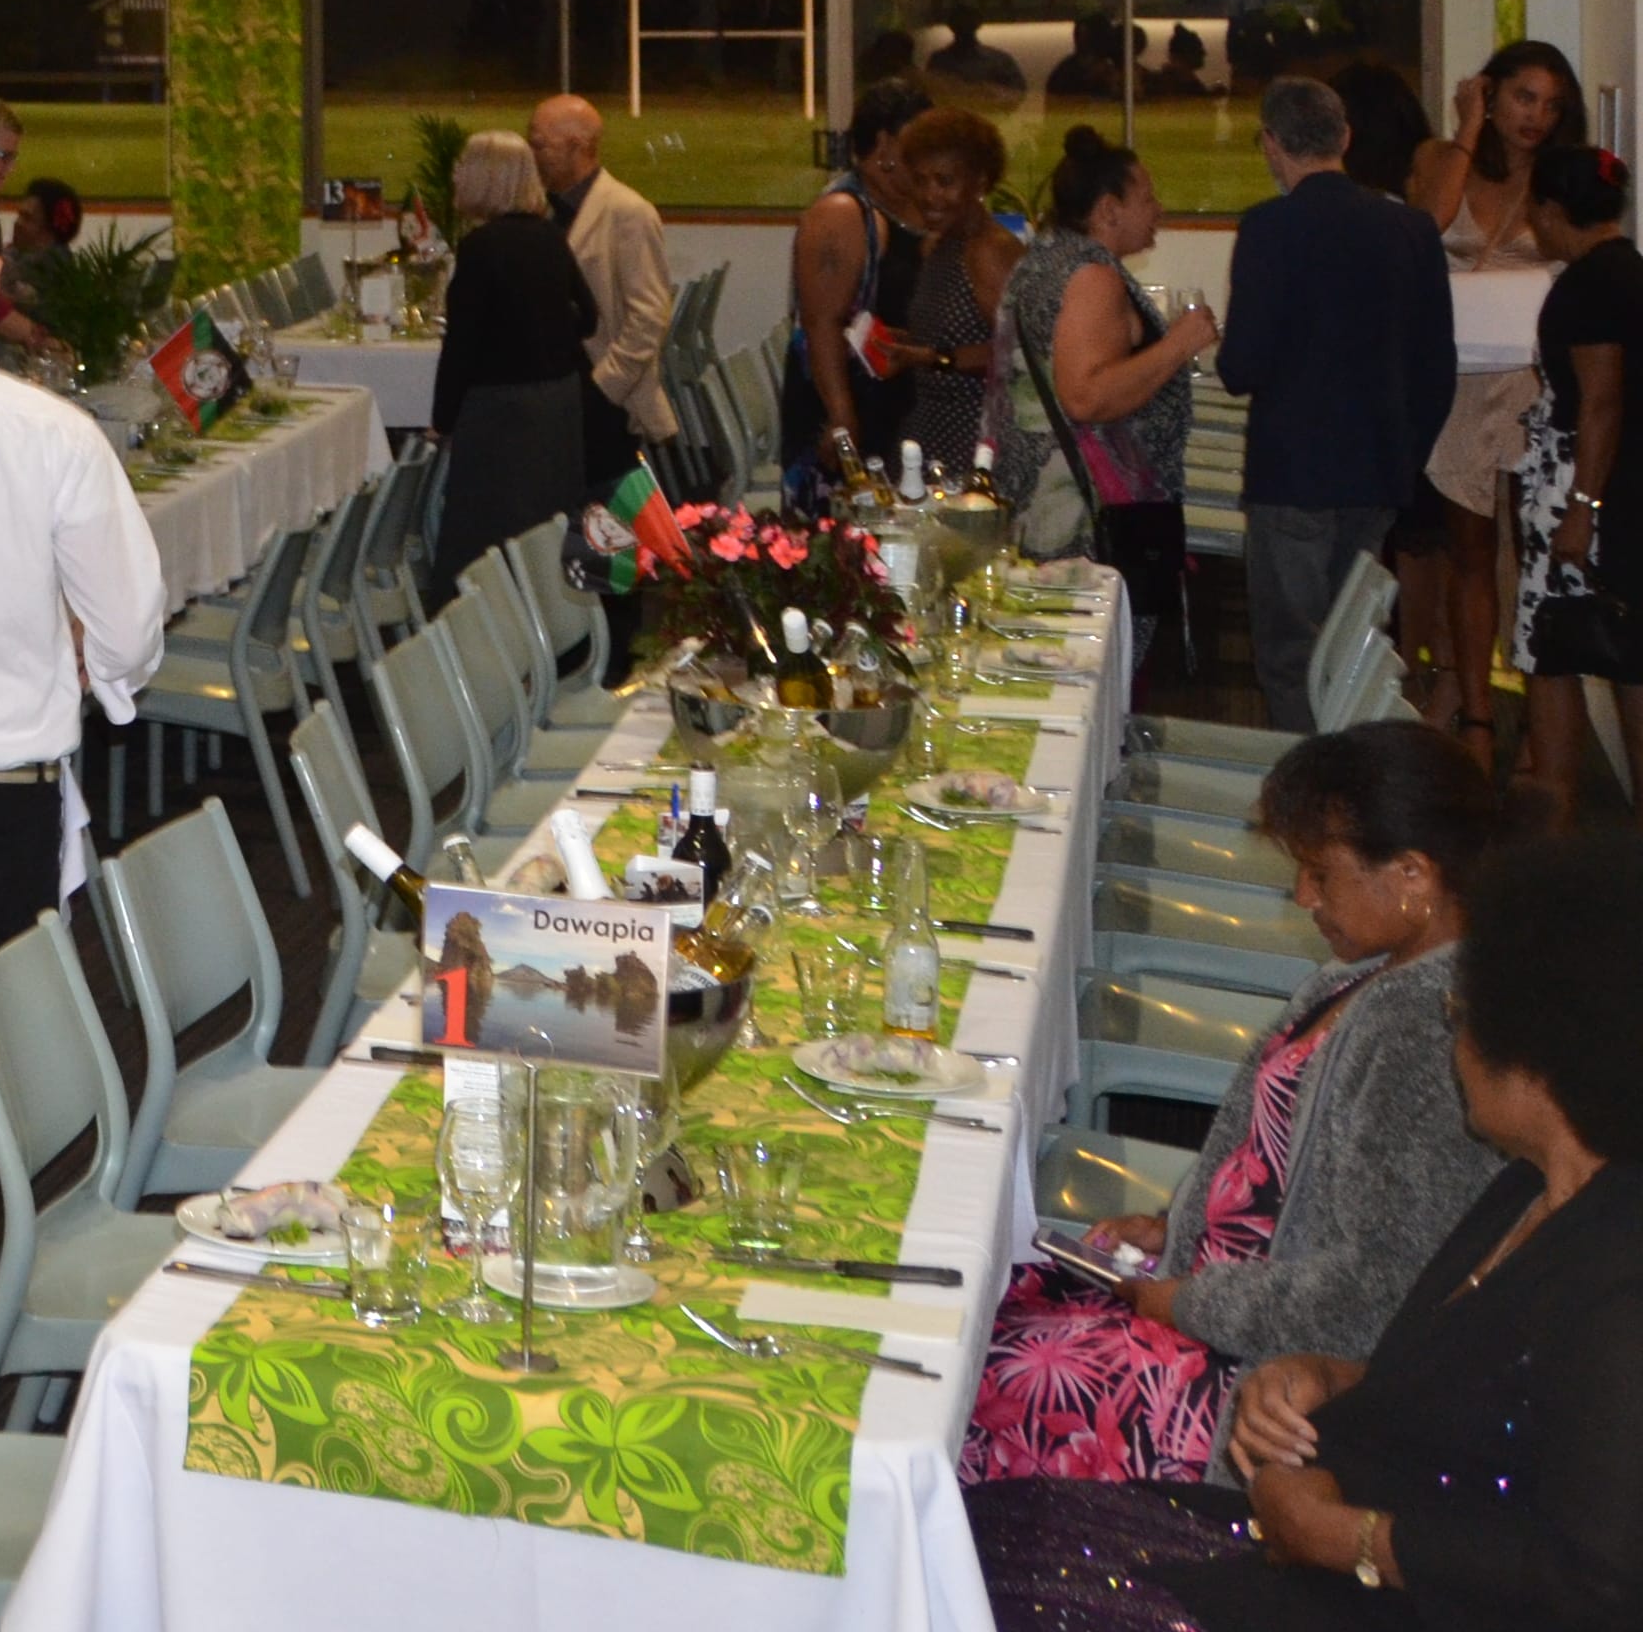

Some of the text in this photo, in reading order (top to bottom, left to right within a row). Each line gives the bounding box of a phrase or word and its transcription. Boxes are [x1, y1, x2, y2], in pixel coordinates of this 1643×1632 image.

[323, 180, 345, 205] 13
[533, 909, 656, 944] Dawapia
[434, 966, 476, 1049] 1
